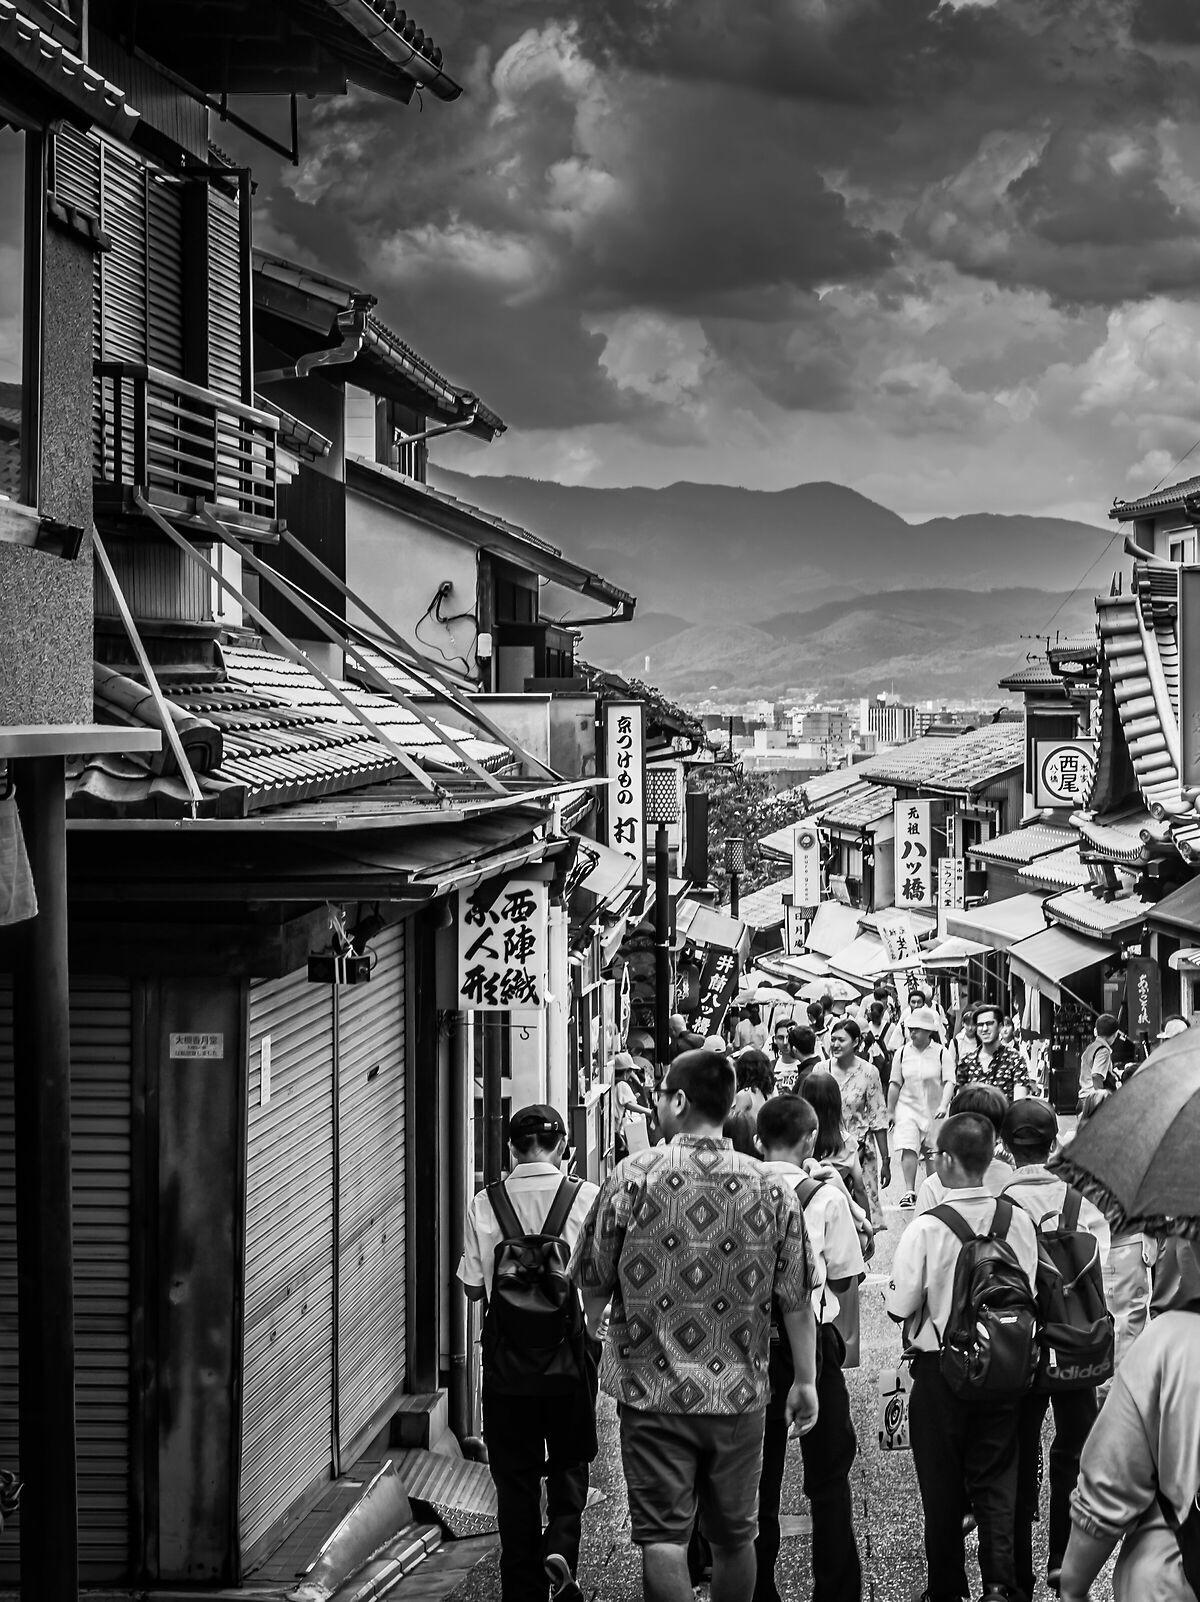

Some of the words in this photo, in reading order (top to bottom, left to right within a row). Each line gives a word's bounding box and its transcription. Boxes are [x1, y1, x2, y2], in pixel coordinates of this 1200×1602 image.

[616, 715, 633, 805] 京つけもの
[1057, 755, 1080, 793] 西尾
[613, 816, 638, 861] 打
[907, 806, 921, 835] 元祖
[500, 889, 540, 1006] 西陣織
[1046, 1362, 1111, 1380] adidas
